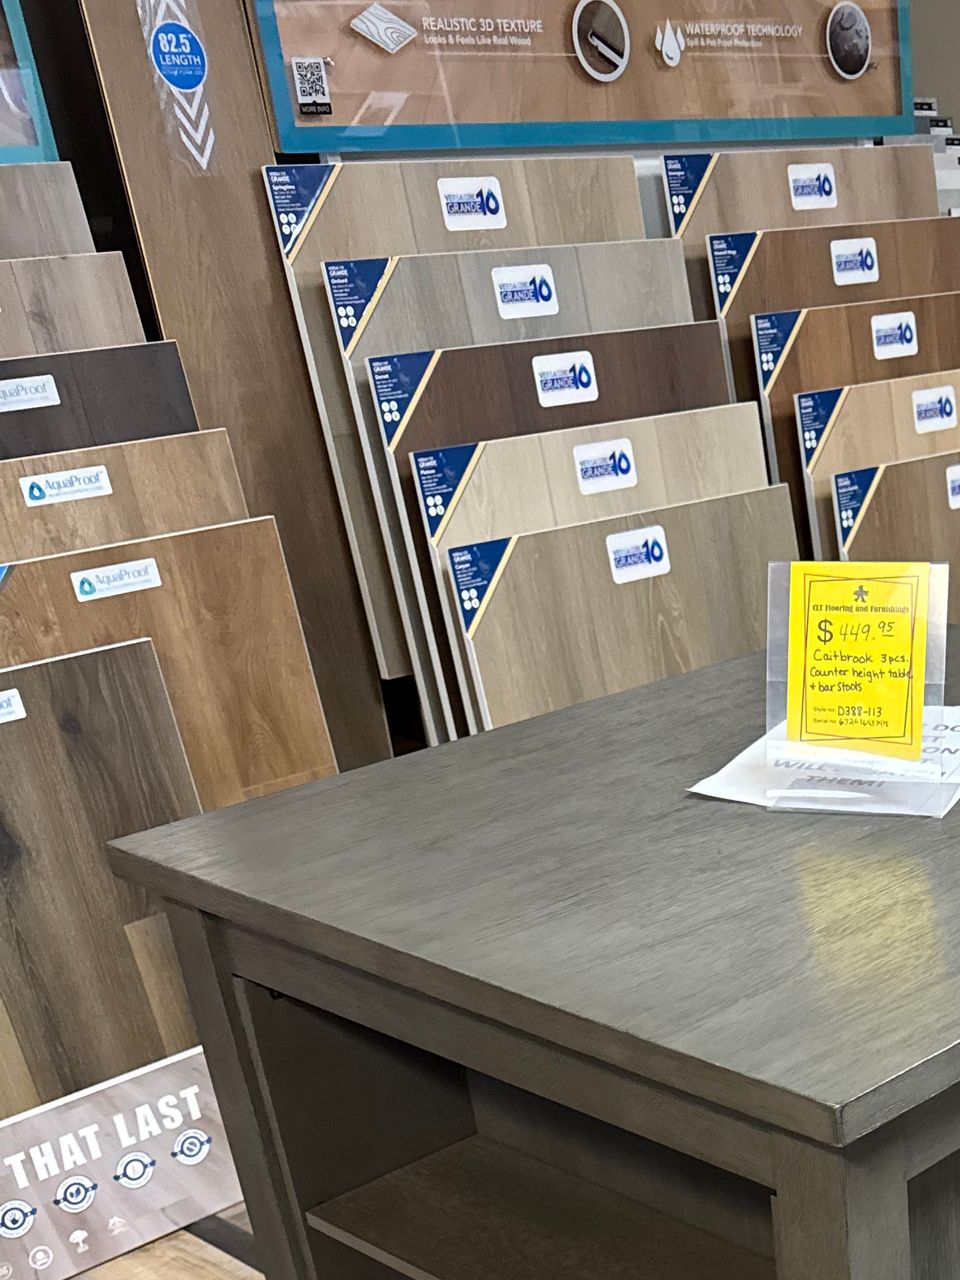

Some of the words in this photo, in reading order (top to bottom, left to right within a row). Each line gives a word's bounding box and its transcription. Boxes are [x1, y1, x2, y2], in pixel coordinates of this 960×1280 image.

[422, 17, 477, 32] REALISTIC
[479, 18, 494, 32] 3D
[496, 18, 543, 33] TEXTURE
[685, 23, 745, 36] WATERPROOF
[746, 24, 803, 37] TECHNOLOGY
[424, 34, 446, 45] Looks
[456, 35, 475, 45] Feels
[476, 35, 491, 45] Like
[509, 36, 531, 46] Wood
[158, 54, 202, 66] LENGTH
[446, 201, 481, 214] GRANDE
[500, 290, 534, 302] GRANDE
[541, 377, 575, 391] GRANDE
[580, 464, 615, 480] GRANDE
[45, 473, 101, 492] AquaProof
[614, 552, 649, 569] GRANDE
[95, 564, 150, 587] AquaProof
[825, 604, 853, 613] Flooring
[870, 605, 909, 614] Furnishings
[817, 618, 834, 646] $
[809, 666, 849, 678] Counter
[852, 667, 886, 683] height
[818, 682, 836, 692] bar
[837, 705, 882, 718] D388-113
[774, 758, 827, 771] WILL
[4, 1124, 103, 1189] THAT
[113, 1085, 203, 1149] LAST
